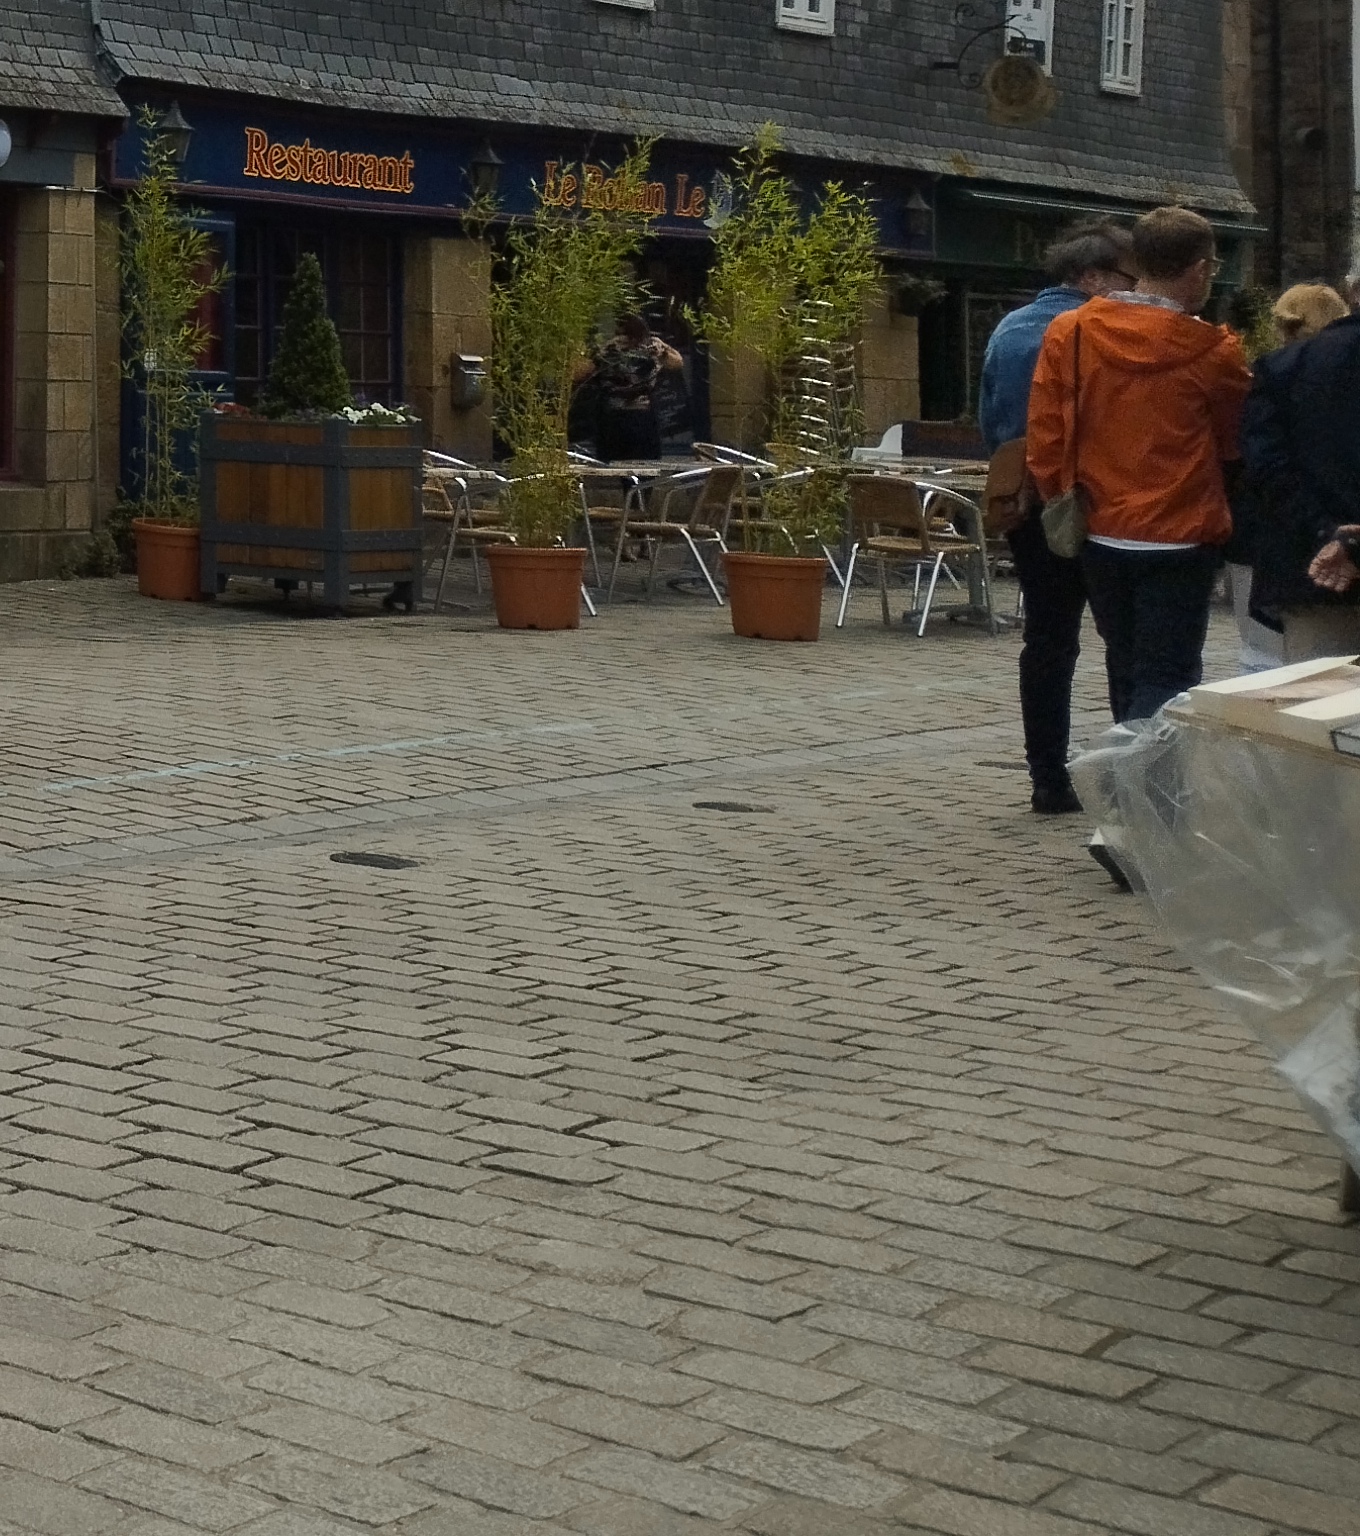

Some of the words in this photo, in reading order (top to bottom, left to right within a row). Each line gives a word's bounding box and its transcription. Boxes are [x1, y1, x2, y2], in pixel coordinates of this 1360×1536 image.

[243, 126, 415, 194] Restaurant
[541, 160, 577, 207] Le
[673, 173, 706, 218] Le
